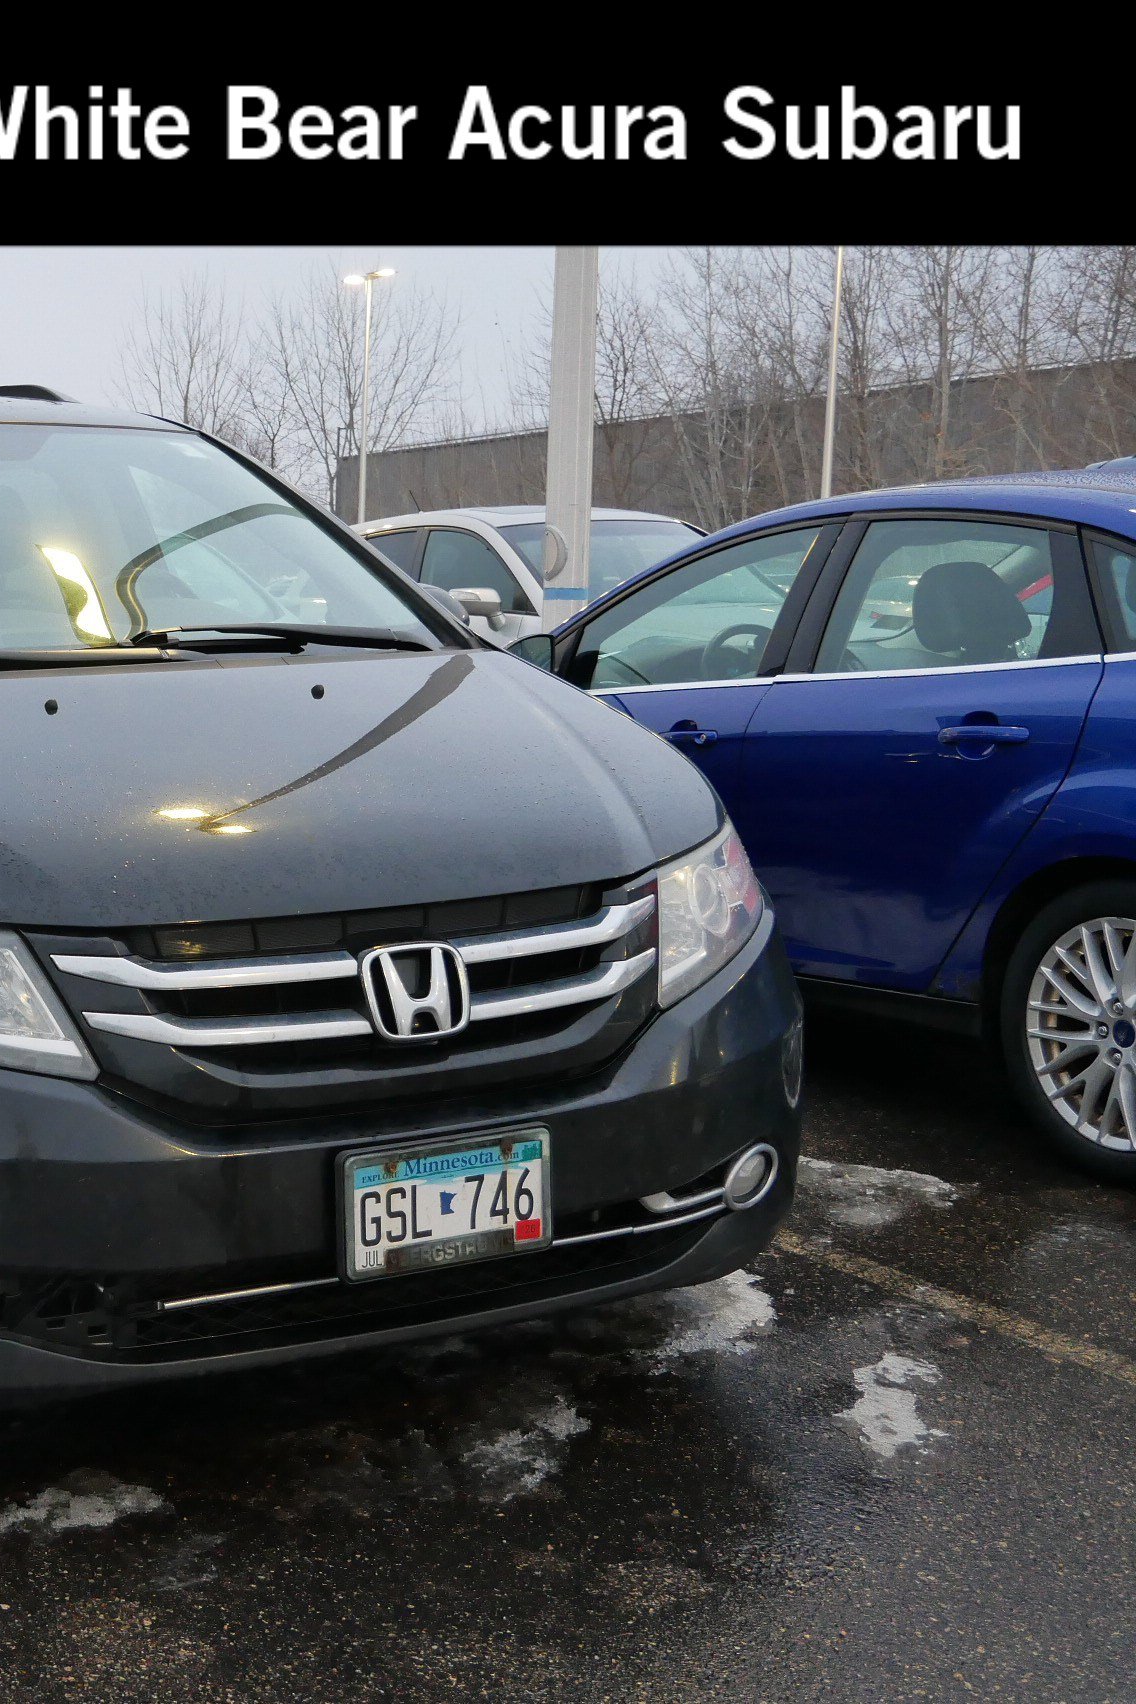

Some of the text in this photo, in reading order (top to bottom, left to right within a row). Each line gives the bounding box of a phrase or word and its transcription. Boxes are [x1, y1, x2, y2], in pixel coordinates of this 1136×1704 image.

[359, 1168, 534, 1248] GSL 746
[361, 1249, 383, 1269] JUL
